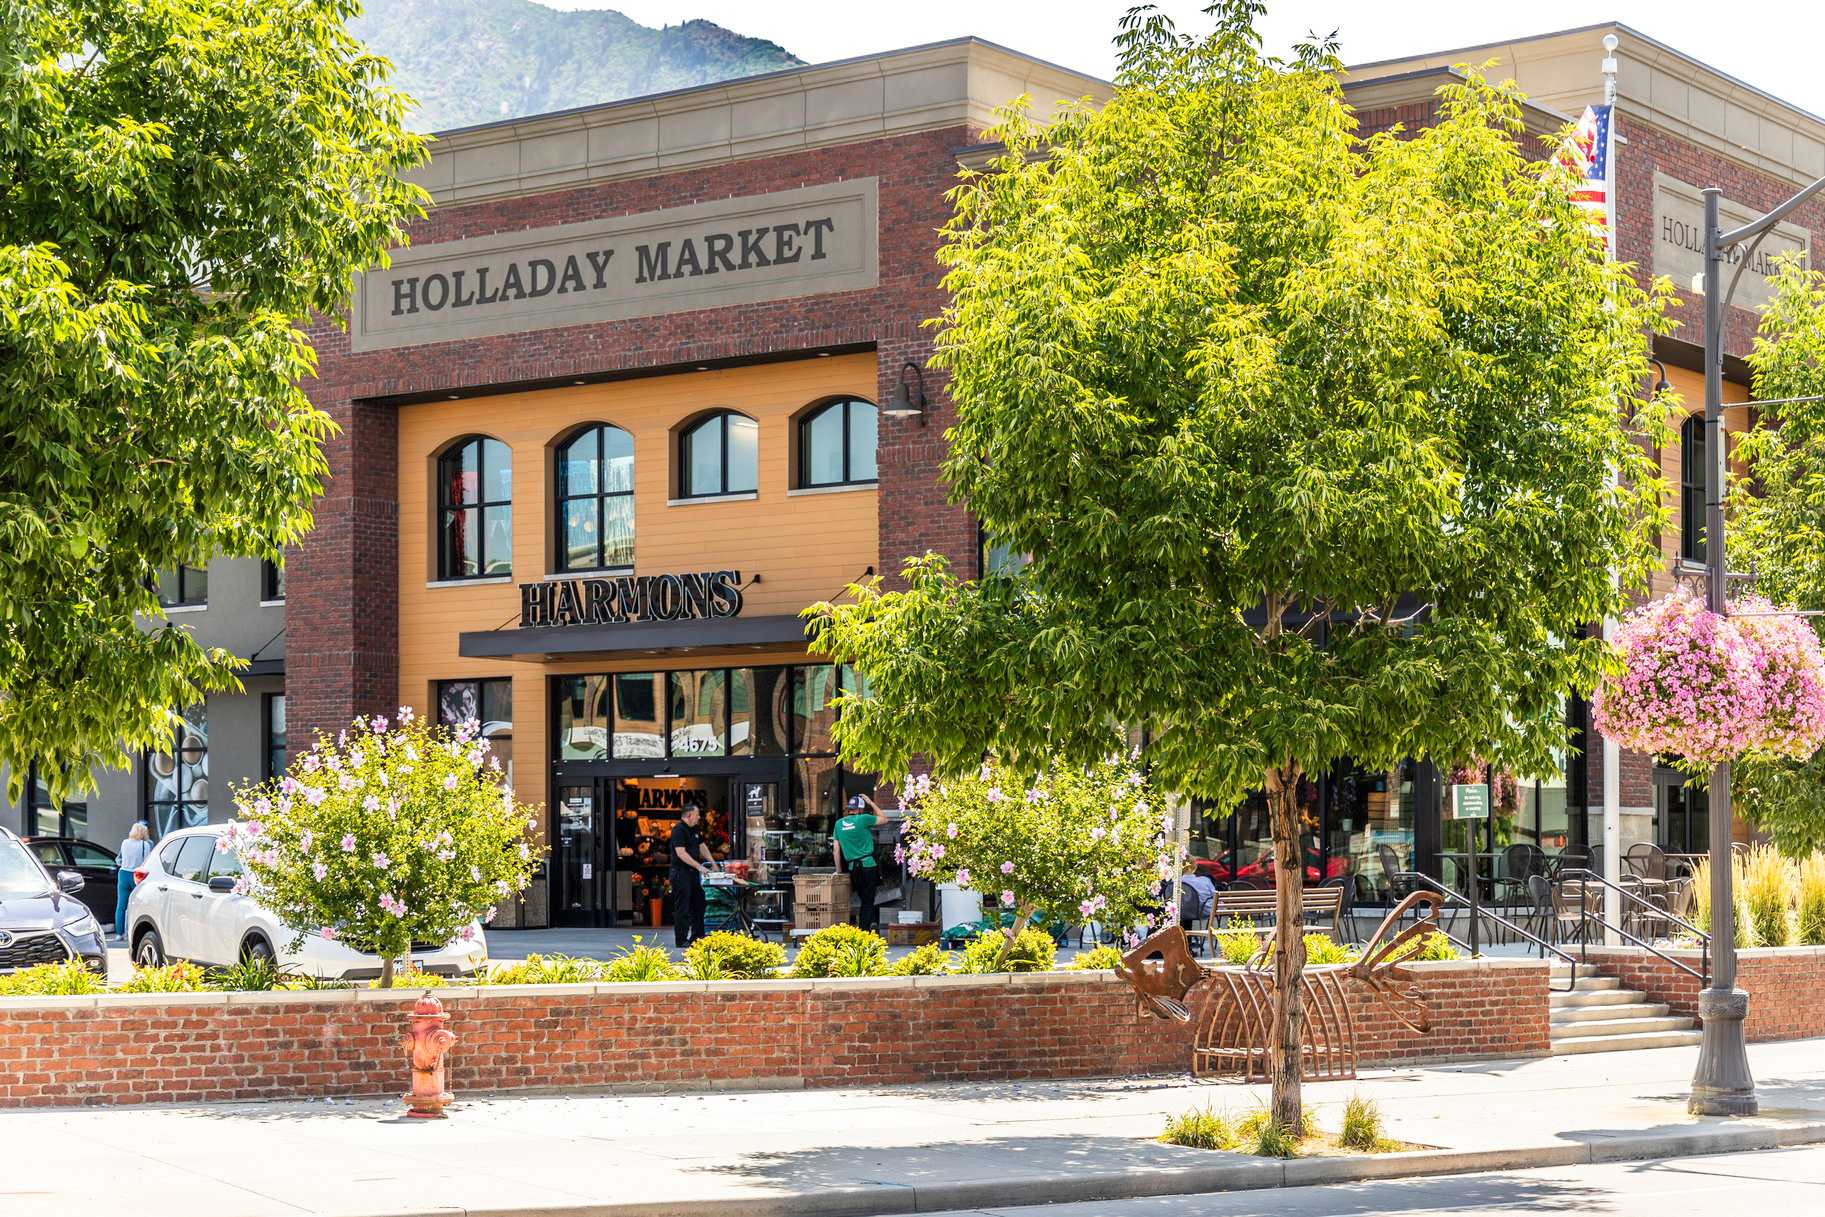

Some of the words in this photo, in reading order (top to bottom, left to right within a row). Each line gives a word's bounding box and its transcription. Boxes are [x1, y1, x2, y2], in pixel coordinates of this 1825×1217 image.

[391, 249, 614, 316] HOLLADAY
[635, 217, 834, 284] MARKET
[518, 570, 743, 629] HARMONS
[678, 736, 719, 753] 4675
